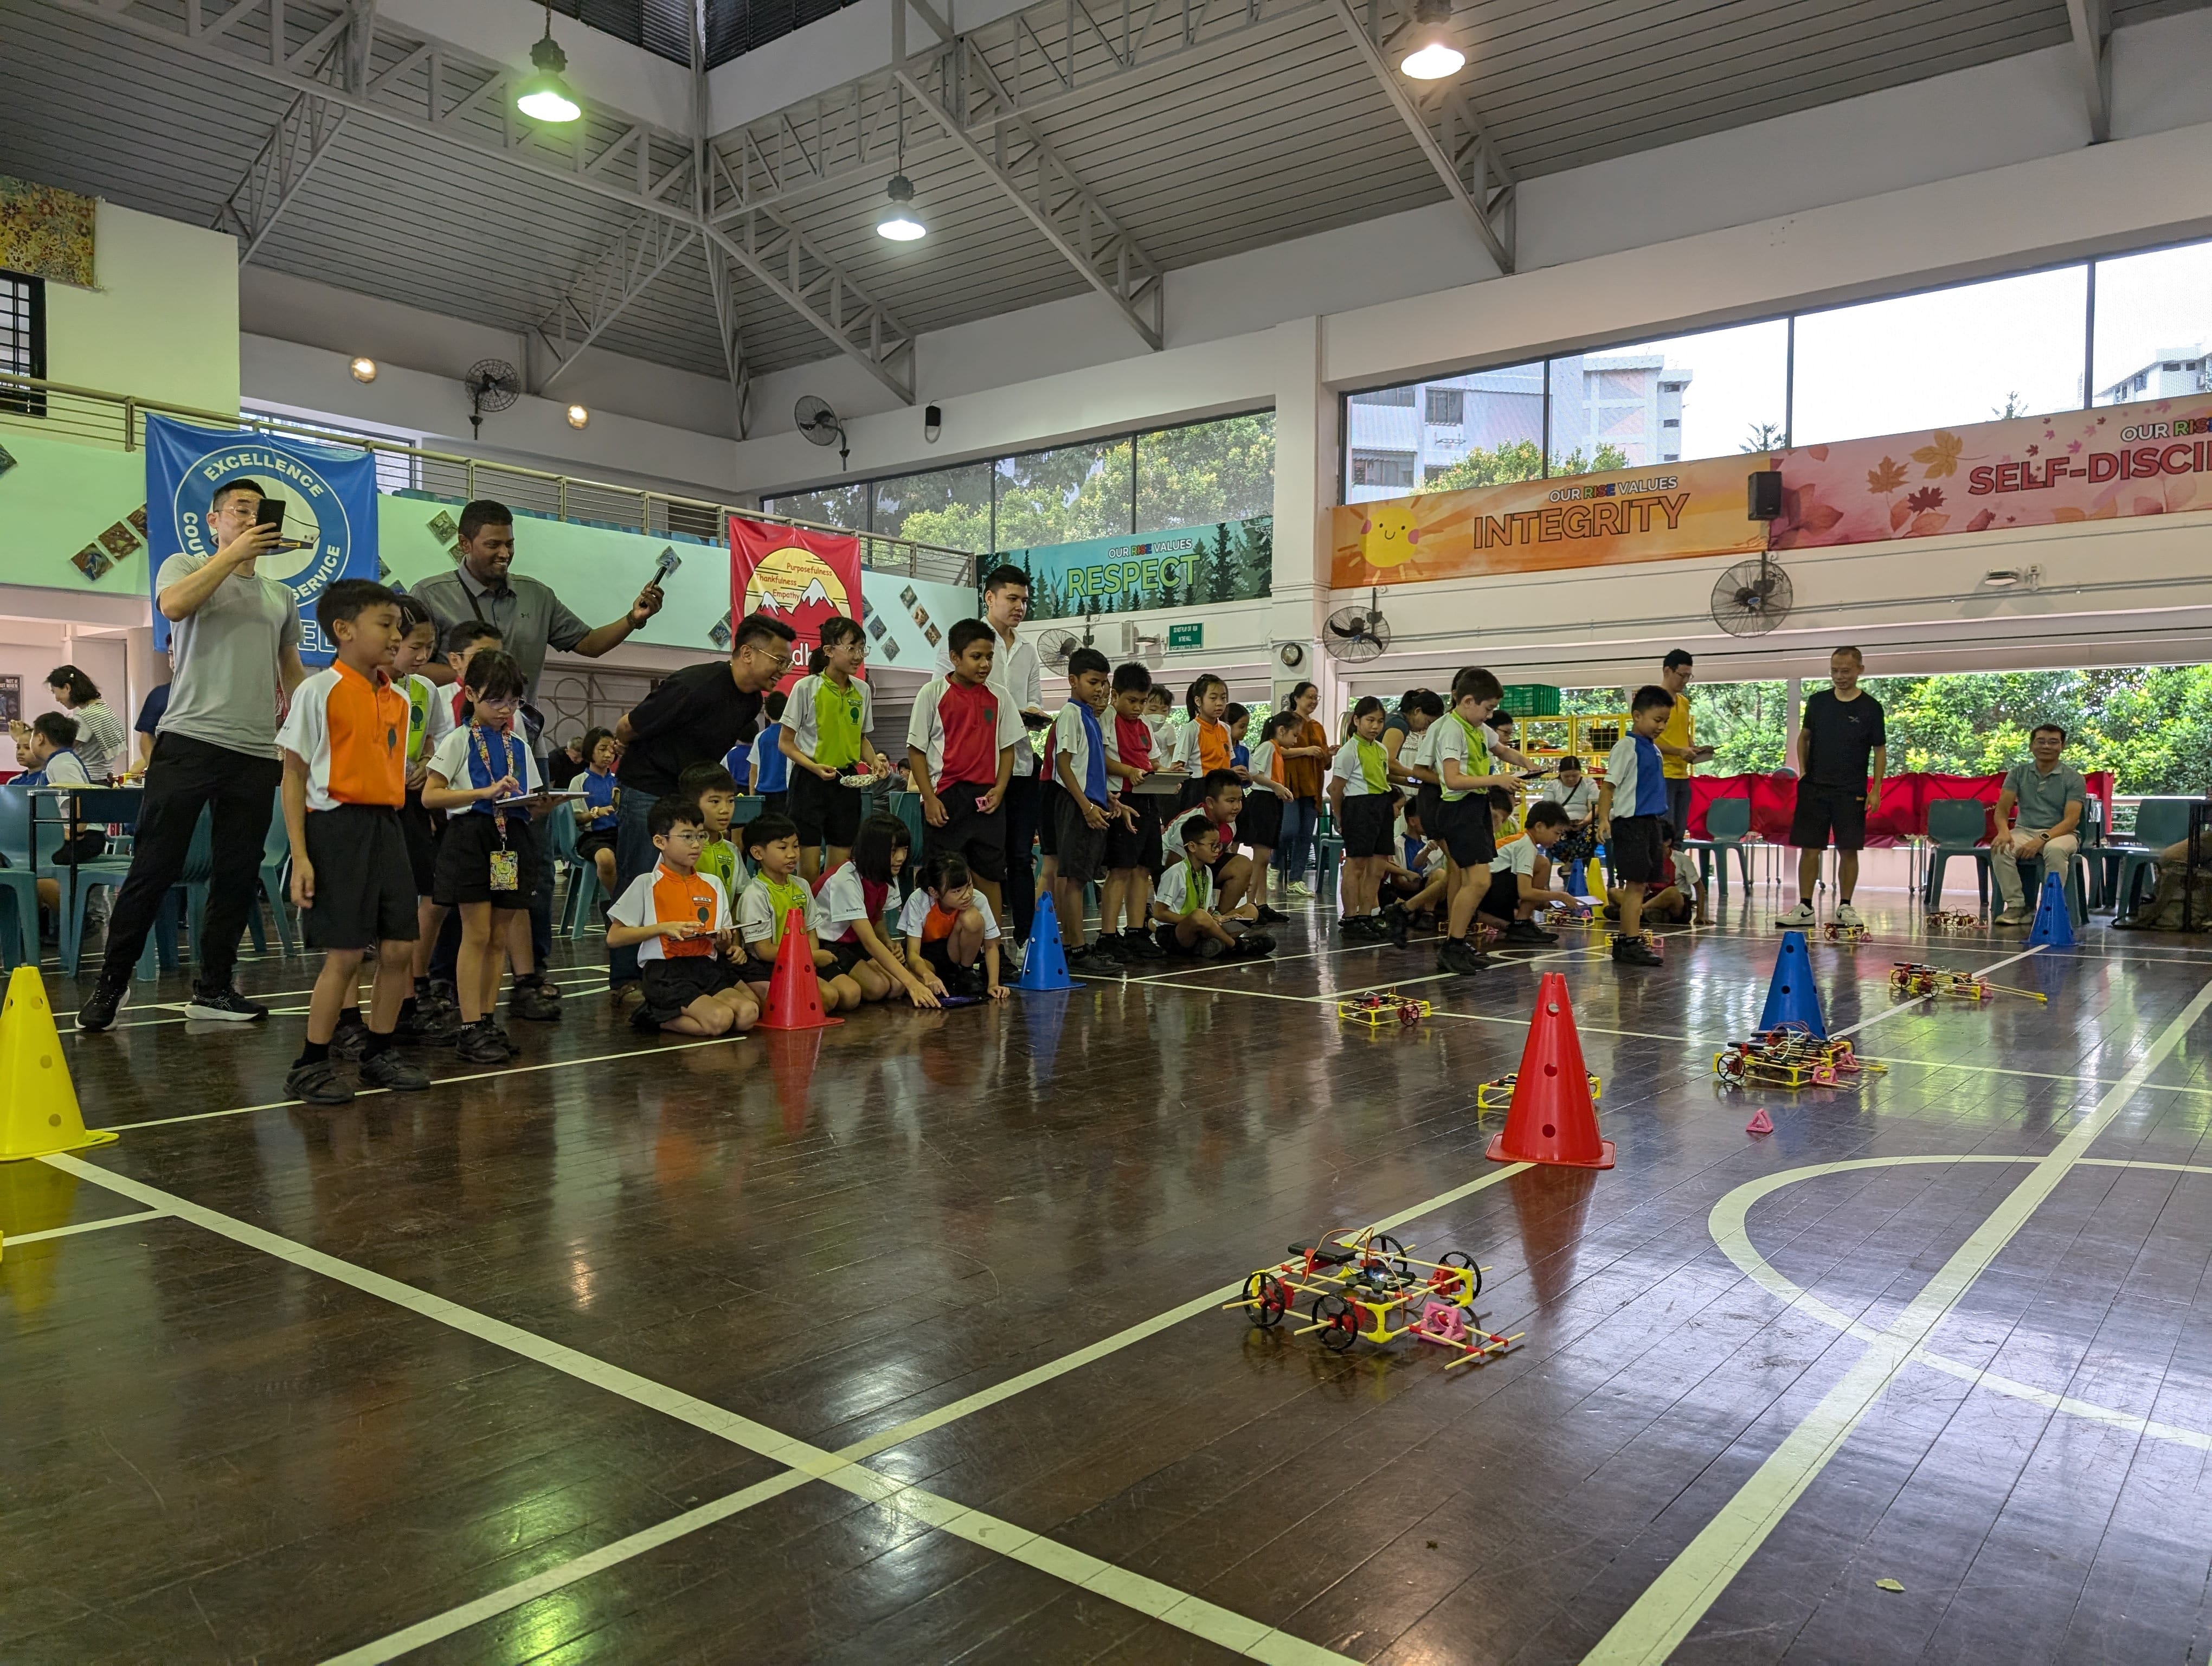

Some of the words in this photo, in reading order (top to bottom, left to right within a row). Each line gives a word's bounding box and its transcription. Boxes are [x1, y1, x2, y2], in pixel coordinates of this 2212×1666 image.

[2120, 422, 2170, 442] OUR
[203, 453, 324, 498] EXCELLENCE
[1968, 440, 2212, 496] SELF-DISCI
[1549, 489, 1580, 503] OUR
[1583, 483, 1616, 499] RISE
[1618, 477, 1678, 495] VALUES
[1474, 493, 1690, 549] INTEGRITY
[1108, 547, 1129, 559] OUR
[1131, 543, 1152, 556] RISE
[1154, 539, 1192, 553] VALUES
[756, 574, 796, 586] Thankfulness
[787, 562, 832, 576] Purposefulness
[1067, 554, 1201, 598] RESPECT
[773, 589, 800, 601] Empathy
